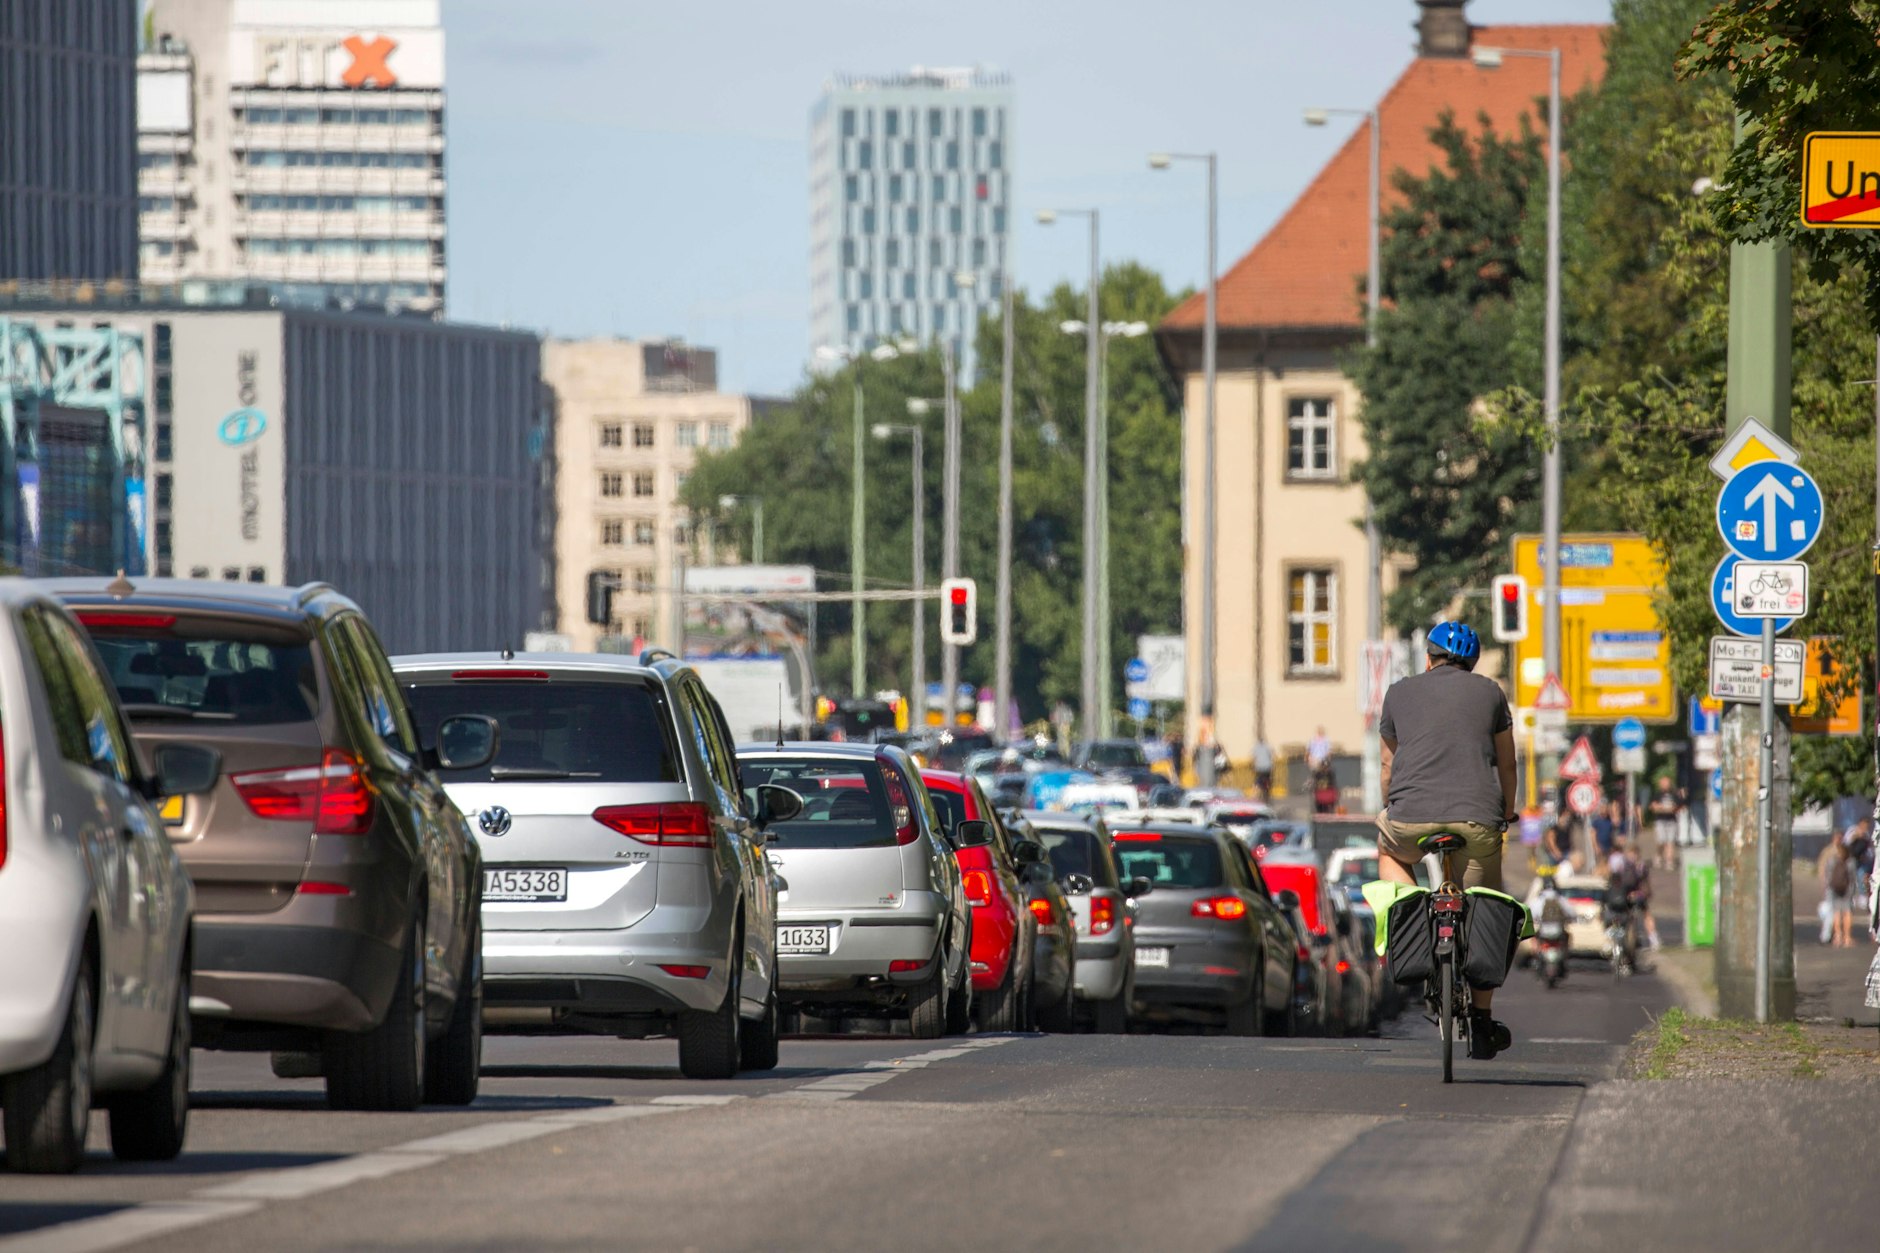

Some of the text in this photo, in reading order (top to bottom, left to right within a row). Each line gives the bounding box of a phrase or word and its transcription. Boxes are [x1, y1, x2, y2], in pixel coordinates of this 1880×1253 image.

[1760, 598, 1781, 610] frei
[1716, 644, 1759, 657] Mo-Fr
[1719, 673, 1794, 687] Krankenfaeuge
[1738, 684, 1755, 694] TAXI
[780, 929, 825, 946] 1033
